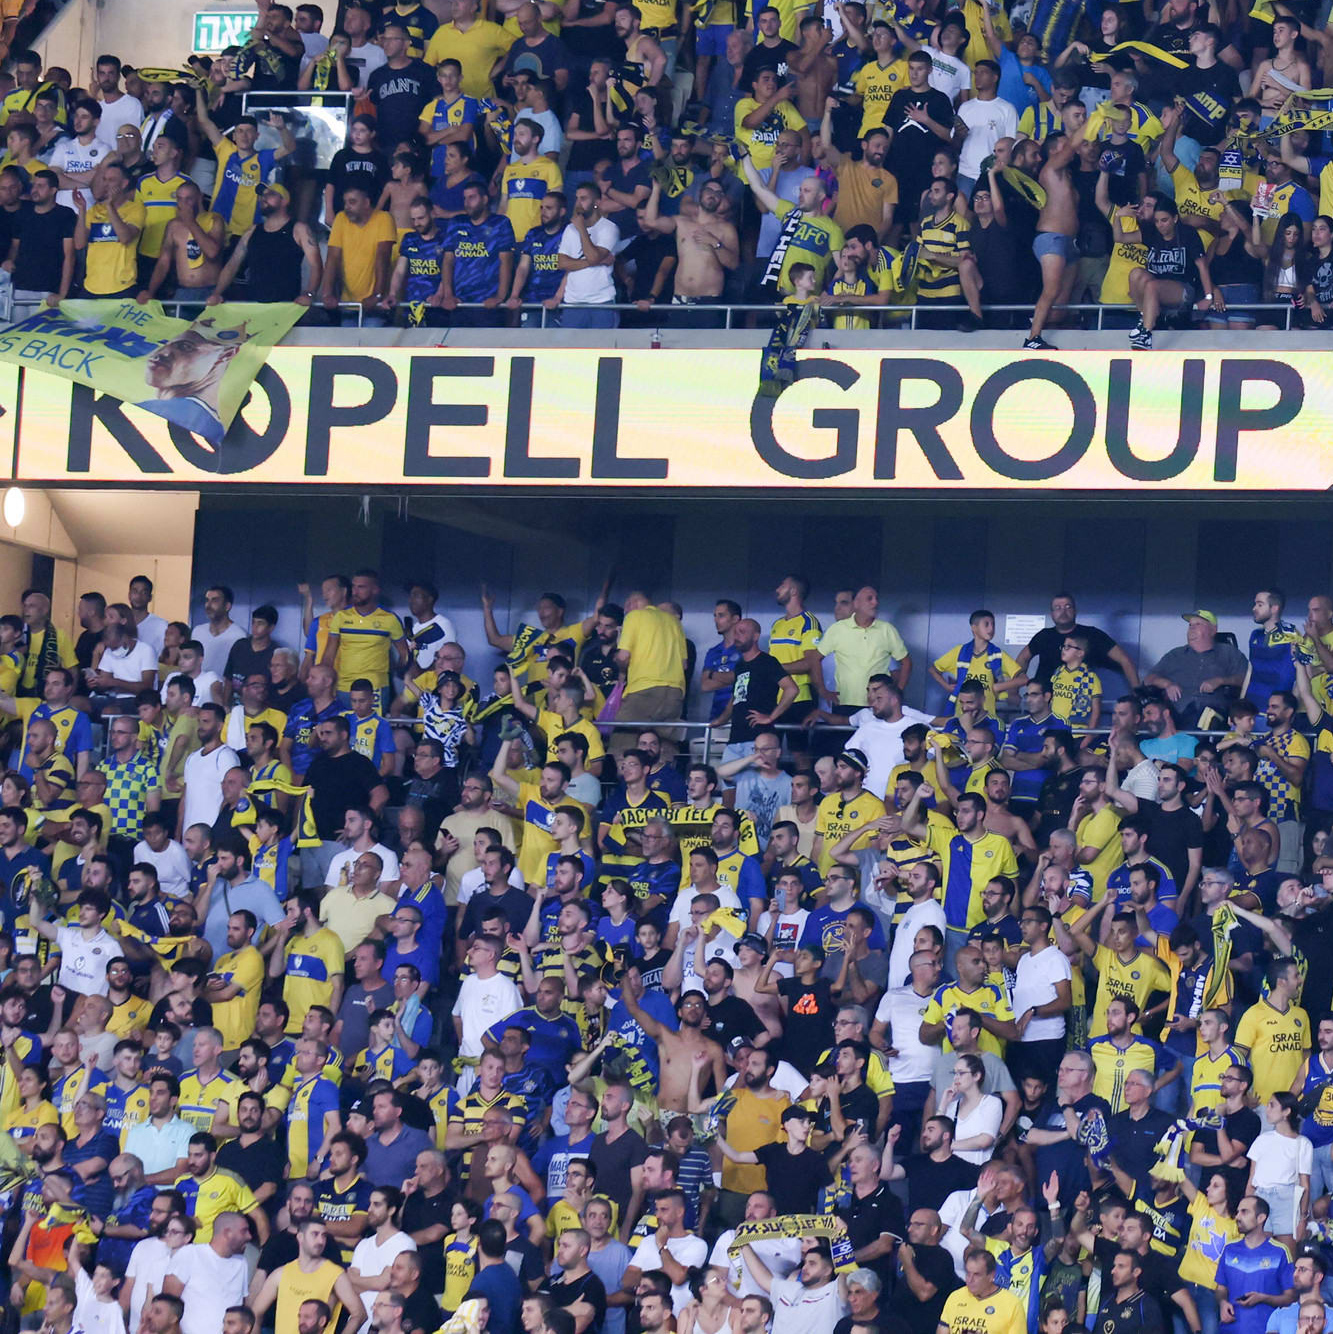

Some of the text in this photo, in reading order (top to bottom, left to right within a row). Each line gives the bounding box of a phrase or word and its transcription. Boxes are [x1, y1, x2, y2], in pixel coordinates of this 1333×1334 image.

[379, 79, 420, 99] GANT
[868, 85, 894, 94] ISRAEL
[345, 162, 361, 172] NEW
[1184, 199, 1211, 215] ISRAEL
[459, 242, 485, 250] ISRAEL
[455, 249, 489, 257] CANADA
[117, 302, 152, 327] THE
[20, 337, 104, 379] BACK
[751, 358, 1305, 482] GROUP
[681, 805, 712, 823] TEL
[827, 824, 851, 832] ISRAEL
[1109, 979, 1134, 991] ISRAEL
[1273, 1033, 1301, 1042] ISRAEL
[954, 1317, 986, 1327] ISRAEL
